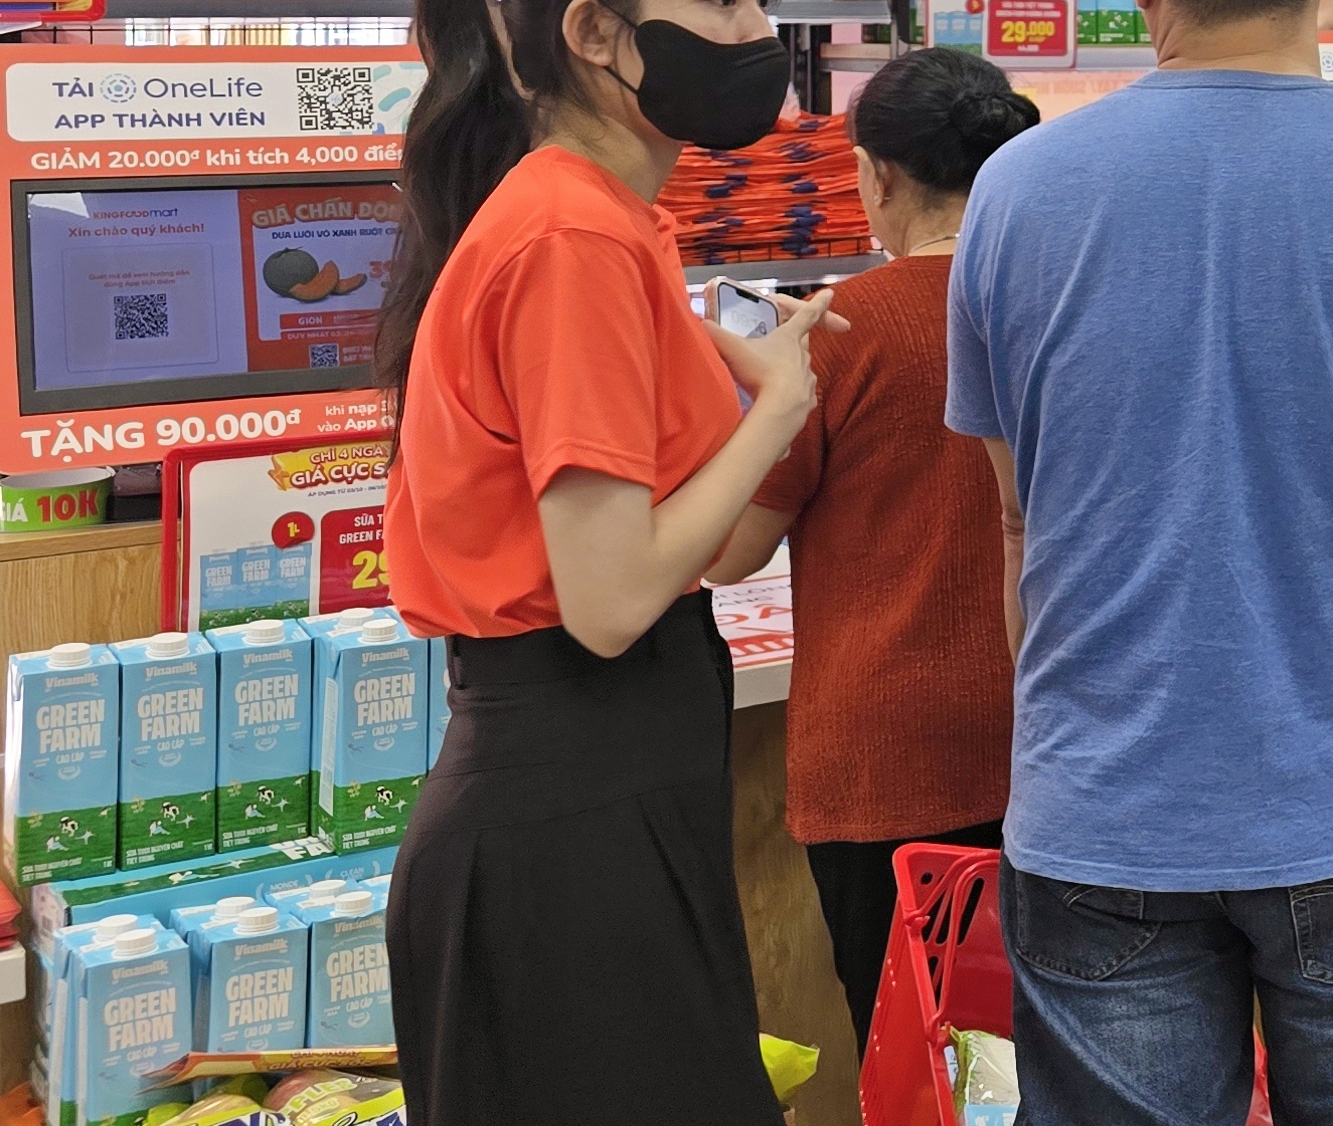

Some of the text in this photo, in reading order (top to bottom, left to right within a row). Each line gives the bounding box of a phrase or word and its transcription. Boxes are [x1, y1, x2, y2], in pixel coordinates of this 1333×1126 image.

[1001, 21, 1055, 43] 29.000
[52, 76, 264, 99] TẢI OneLife
[54, 107, 266, 130] APP THÀNH VIÊN
[30, 145, 101, 171] GIẢM
[205, 147, 241, 167] khi
[246, 146, 290, 166] tích
[295, 146, 359, 165] 4,000
[253, 203, 291, 226] GIÁ
[68, 222, 205, 238] Xin chào quý khách!
[325, 404, 344, 418] khi
[347, 402, 378, 417] nạp
[20, 408, 302, 464] TẶNG 90.000đ
[317, 416, 377, 433] vào App
[339, 448, 348, 459] 4
[290, 462, 370, 487] GIÁ CỰC
[36, 491, 100, 524] 10K
[353, 512, 375, 527] SỮA
[339, 530, 374, 545] GREEN
[243, 649, 293, 665] Vinamilk
[361, 647, 409, 664] Vinamilk
[45, 672, 99, 689] Vinamilk
[145, 662, 197, 681] Vinamilk
[234, 673, 299, 704] GREEN
[353, 673, 416, 704] GREEN
[36, 699, 105, 730] GREEN
[137, 687, 204, 719] GREEN
[238, 697, 295, 727] FARM
[357, 696, 413, 727] FARM
[140, 711, 200, 742] FARM
[39, 723, 101, 754] FARM
[330, 970, 389, 1003] FARM
